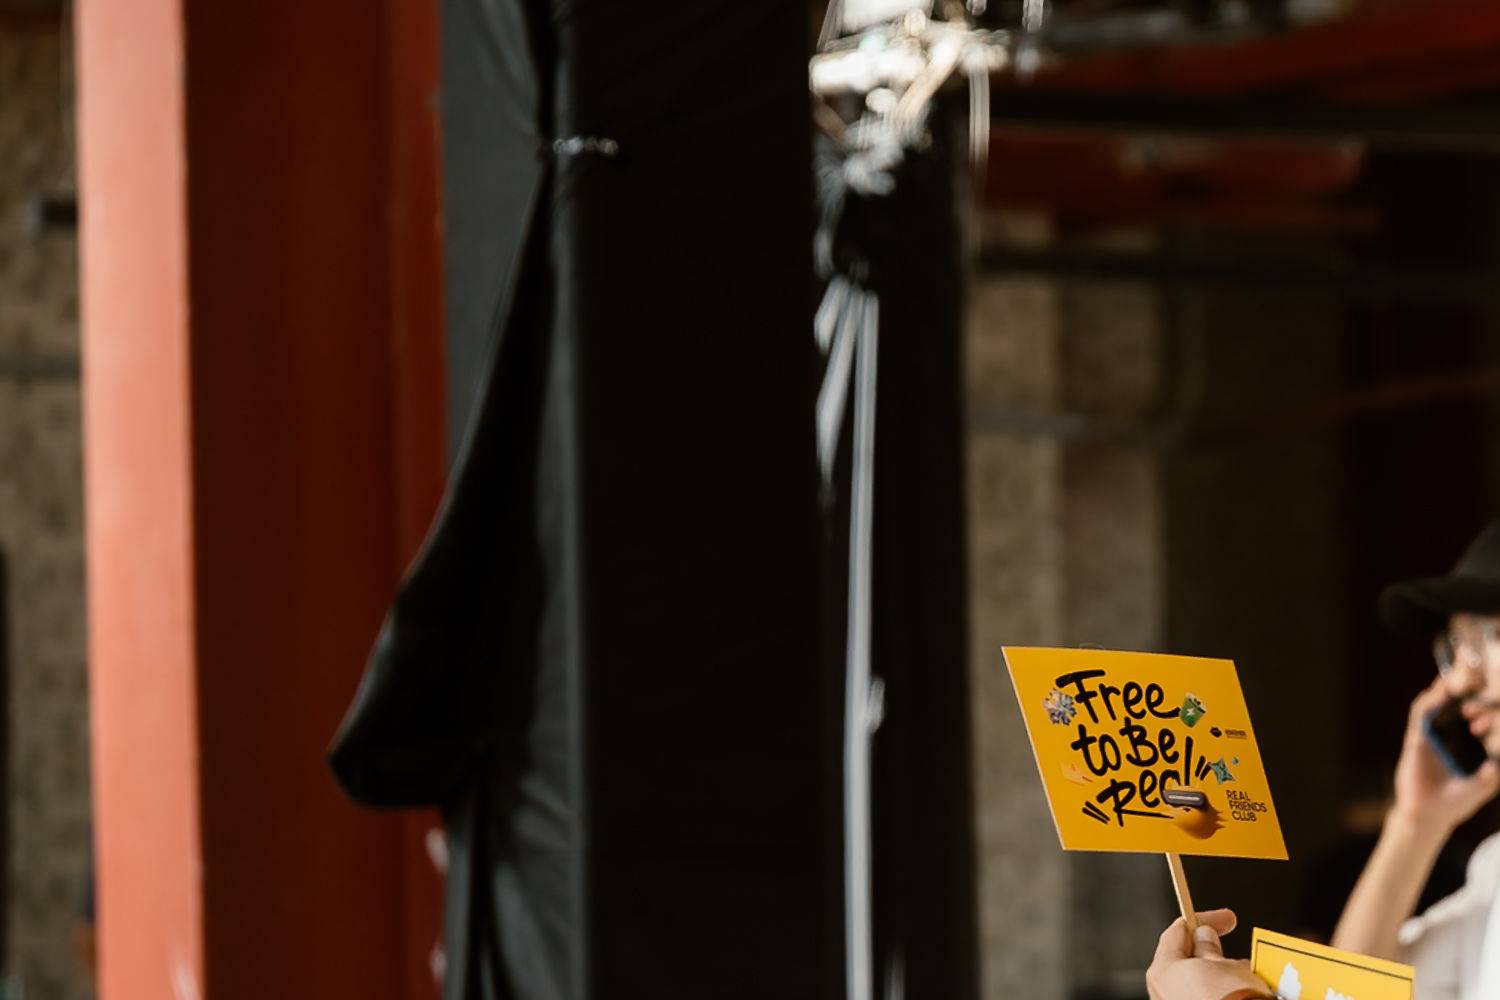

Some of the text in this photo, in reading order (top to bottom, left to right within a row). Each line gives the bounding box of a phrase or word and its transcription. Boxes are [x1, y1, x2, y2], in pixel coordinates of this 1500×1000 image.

[1055, 669, 1180, 724] Free
[1070, 716, 1179, 777] to Be
[1226, 790, 1251, 802] REAL
[1229, 801, 1268, 813] FRIENDS
[1232, 811, 1257, 822] CLUB
